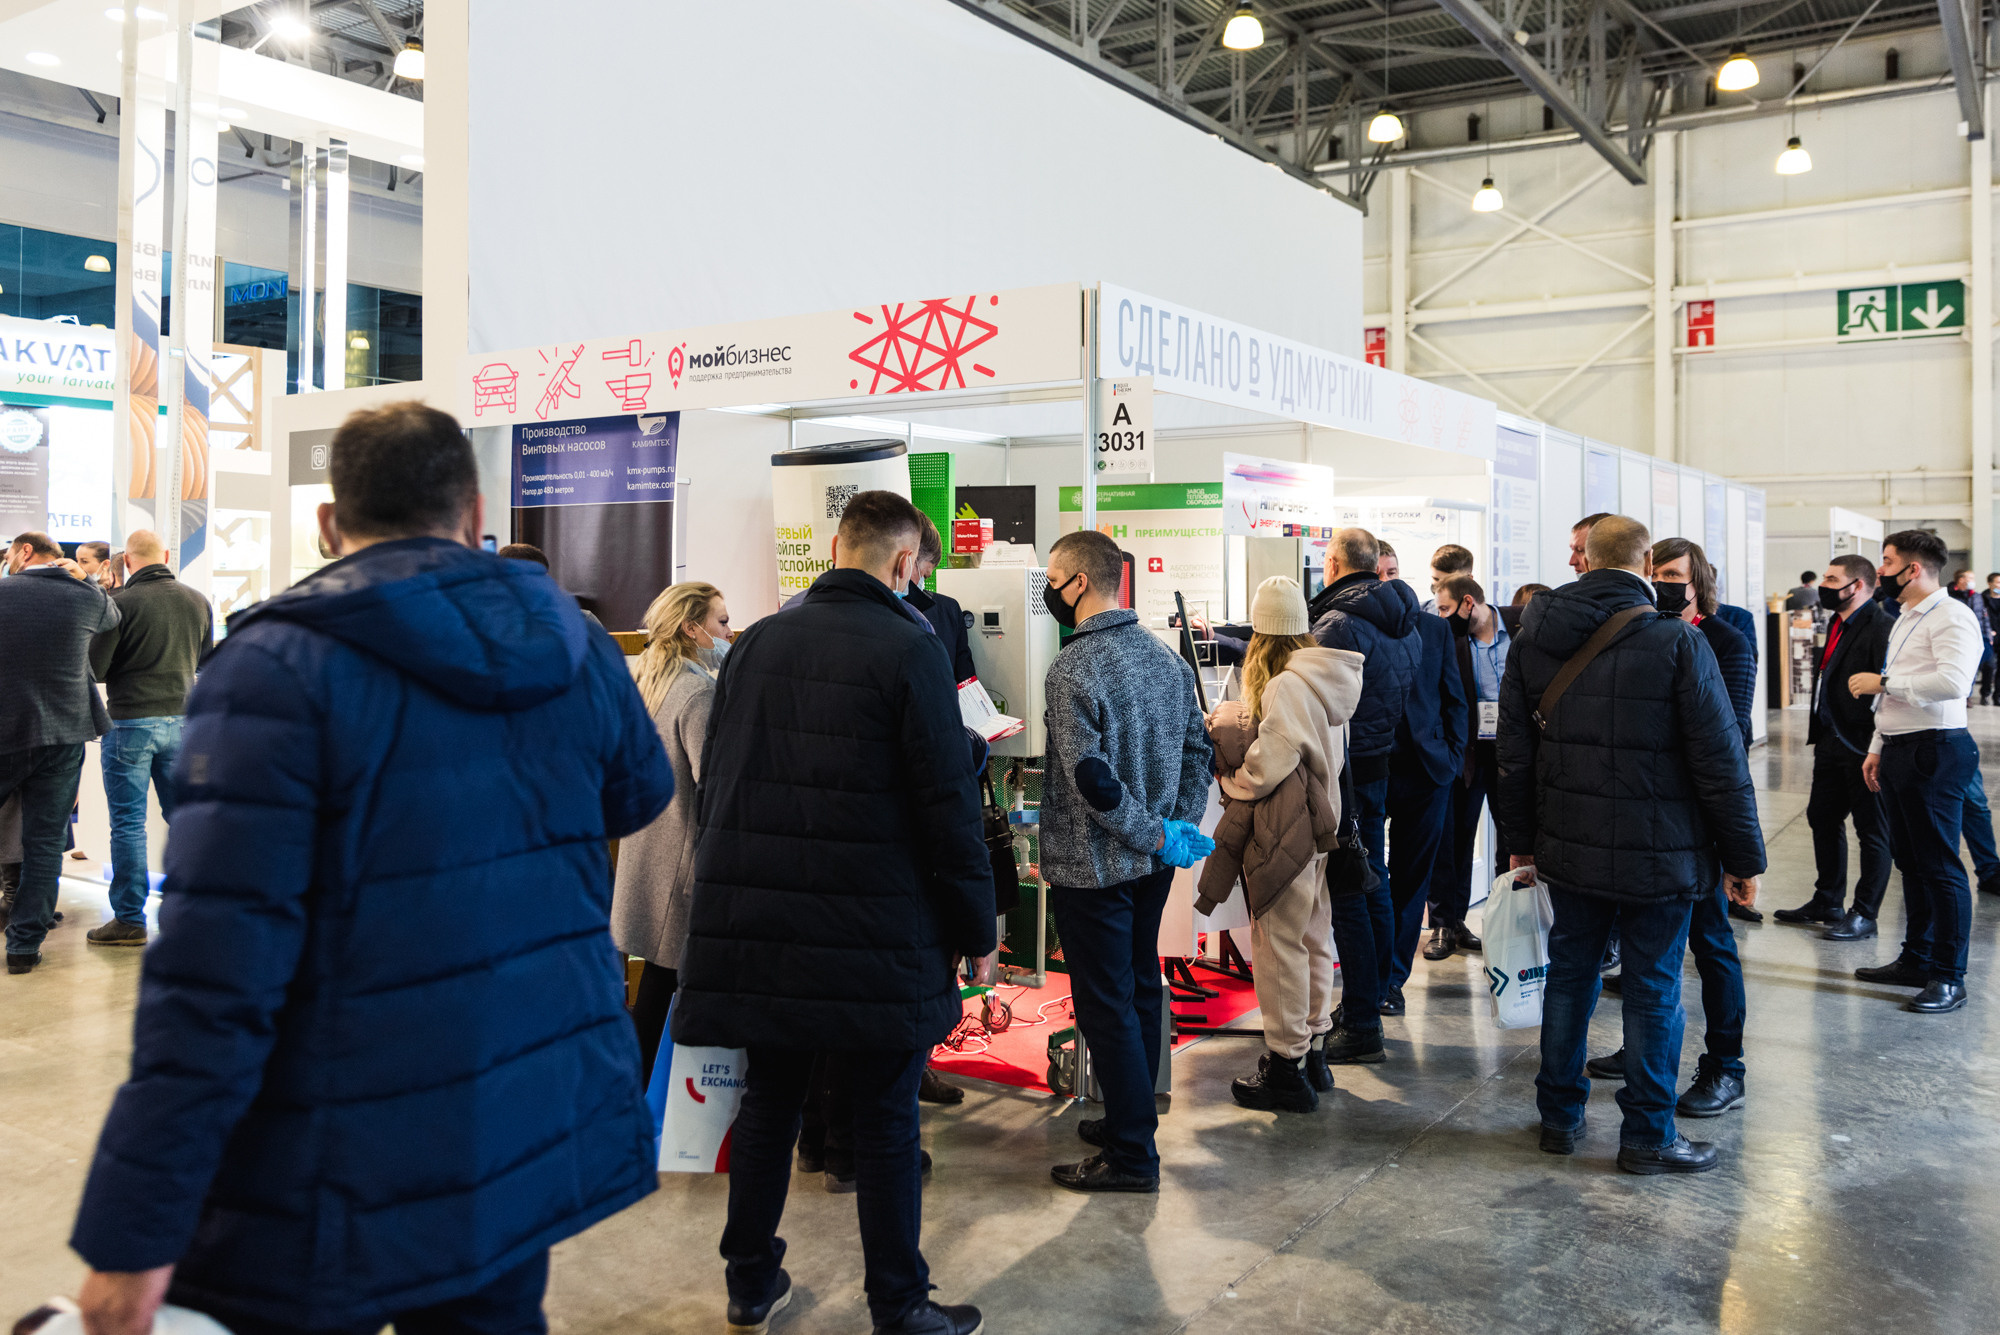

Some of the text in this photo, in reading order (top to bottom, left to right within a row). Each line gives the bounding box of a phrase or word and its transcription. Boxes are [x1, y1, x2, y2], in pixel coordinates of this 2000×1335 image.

[0, 337, 112, 373] AKVAT
[1118, 298, 1373, 424] СДЕЛАНО В УДМУРТИИ
[16, 372, 116, 390] your farvate
[688, 367, 792, 382] поддержка предпринимательства
[1112, 402, 1132, 426] A
[522, 424, 587, 441] Производство
[522, 440, 606, 456] Винтовых насосов
[1098, 430, 1144, 452] 3031
[521, 473, 574, 484] Производительность
[573, 470, 586, 480] 0,01
[589, 469, 600, 478] 400
[600, 468, 614, 479] м3/ч
[627, 465, 675, 477] kmx-pumps.ru
[521, 486, 575, 497] Напор до 480 метров
[627, 480, 676, 491] kamimtex.com
[48, 512, 93, 528] ATER
[776, 524, 813, 540] ЕРВЫЙ
[1135, 528, 1223, 540] ПРЕИМУЩЕСТВА
[776, 541, 811, 556] ОЙЛЕР
[777, 557, 834, 572] ОСЛОЙНО
[778, 576, 818, 589] АГРЕВА
[702, 1063, 731, 1075] LET'S
[701, 1076, 748, 1089] EXCHANG
